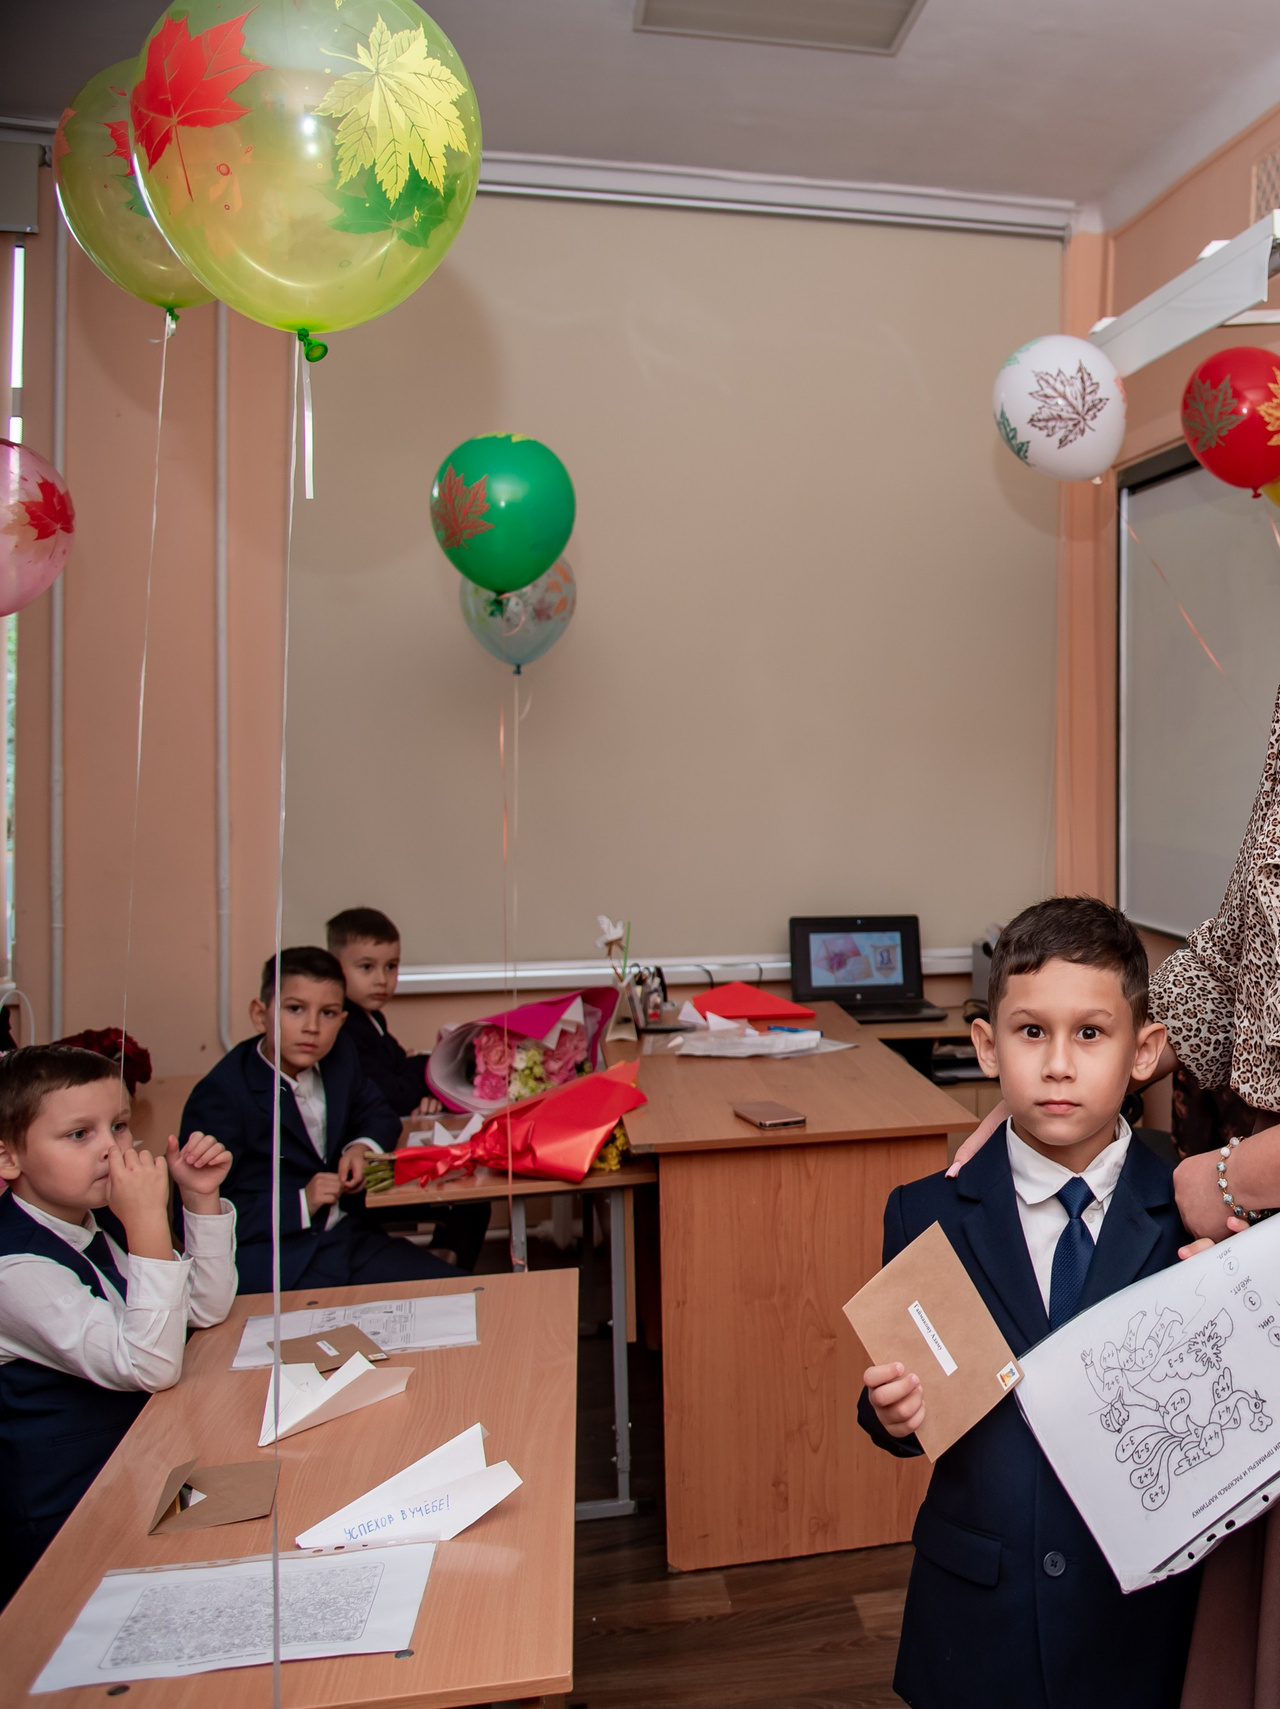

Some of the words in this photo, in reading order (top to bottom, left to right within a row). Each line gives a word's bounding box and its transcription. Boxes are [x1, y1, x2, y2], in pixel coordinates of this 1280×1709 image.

[1247, 1450, 1275, 1473] ПРИМЕРЫ
[1217, 1473, 1244, 1496] РАСКРАСЬ
[1191, 1493, 1219, 1518] КАРТИНКУ
[343, 1514, 394, 1540] УСПЕХОВ
